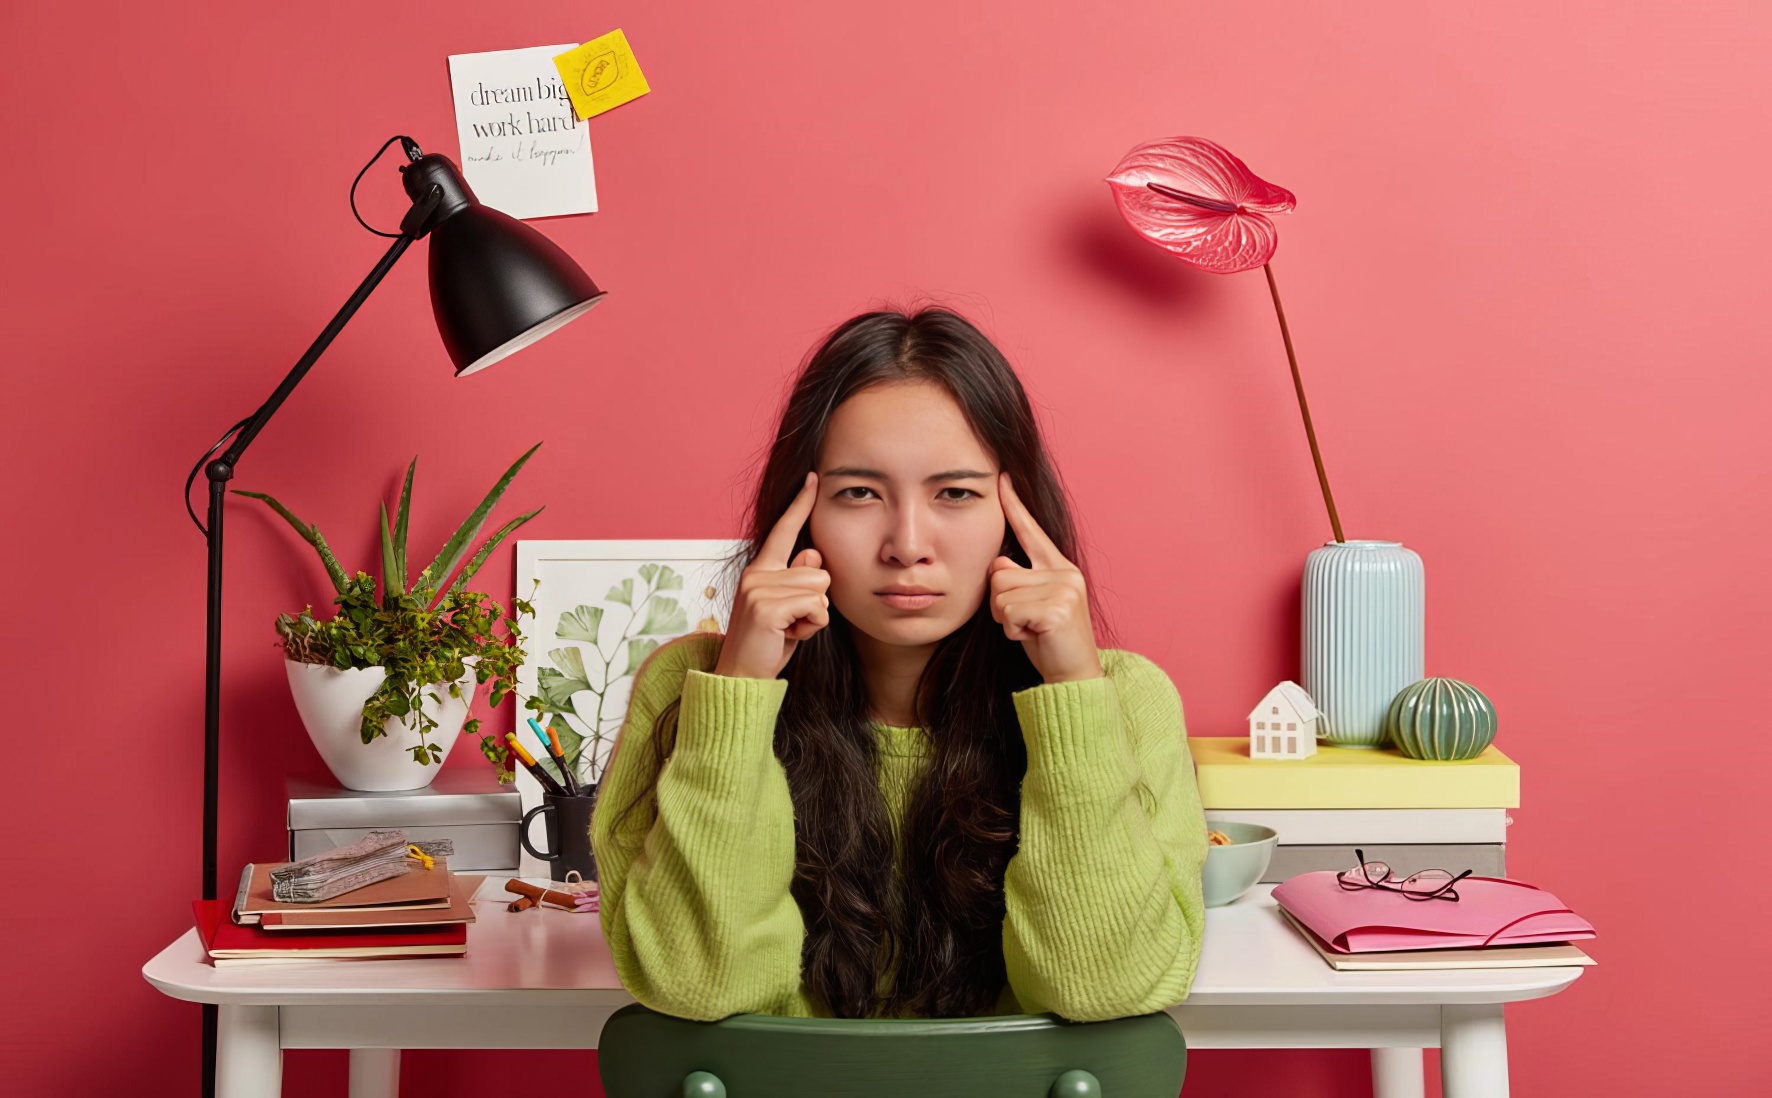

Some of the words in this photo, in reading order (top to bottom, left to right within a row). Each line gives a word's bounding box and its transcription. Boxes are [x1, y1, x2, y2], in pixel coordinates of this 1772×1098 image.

[470, 82, 533, 106] dream
[473, 112, 522, 138] work
[526, 107, 575, 134] hard
